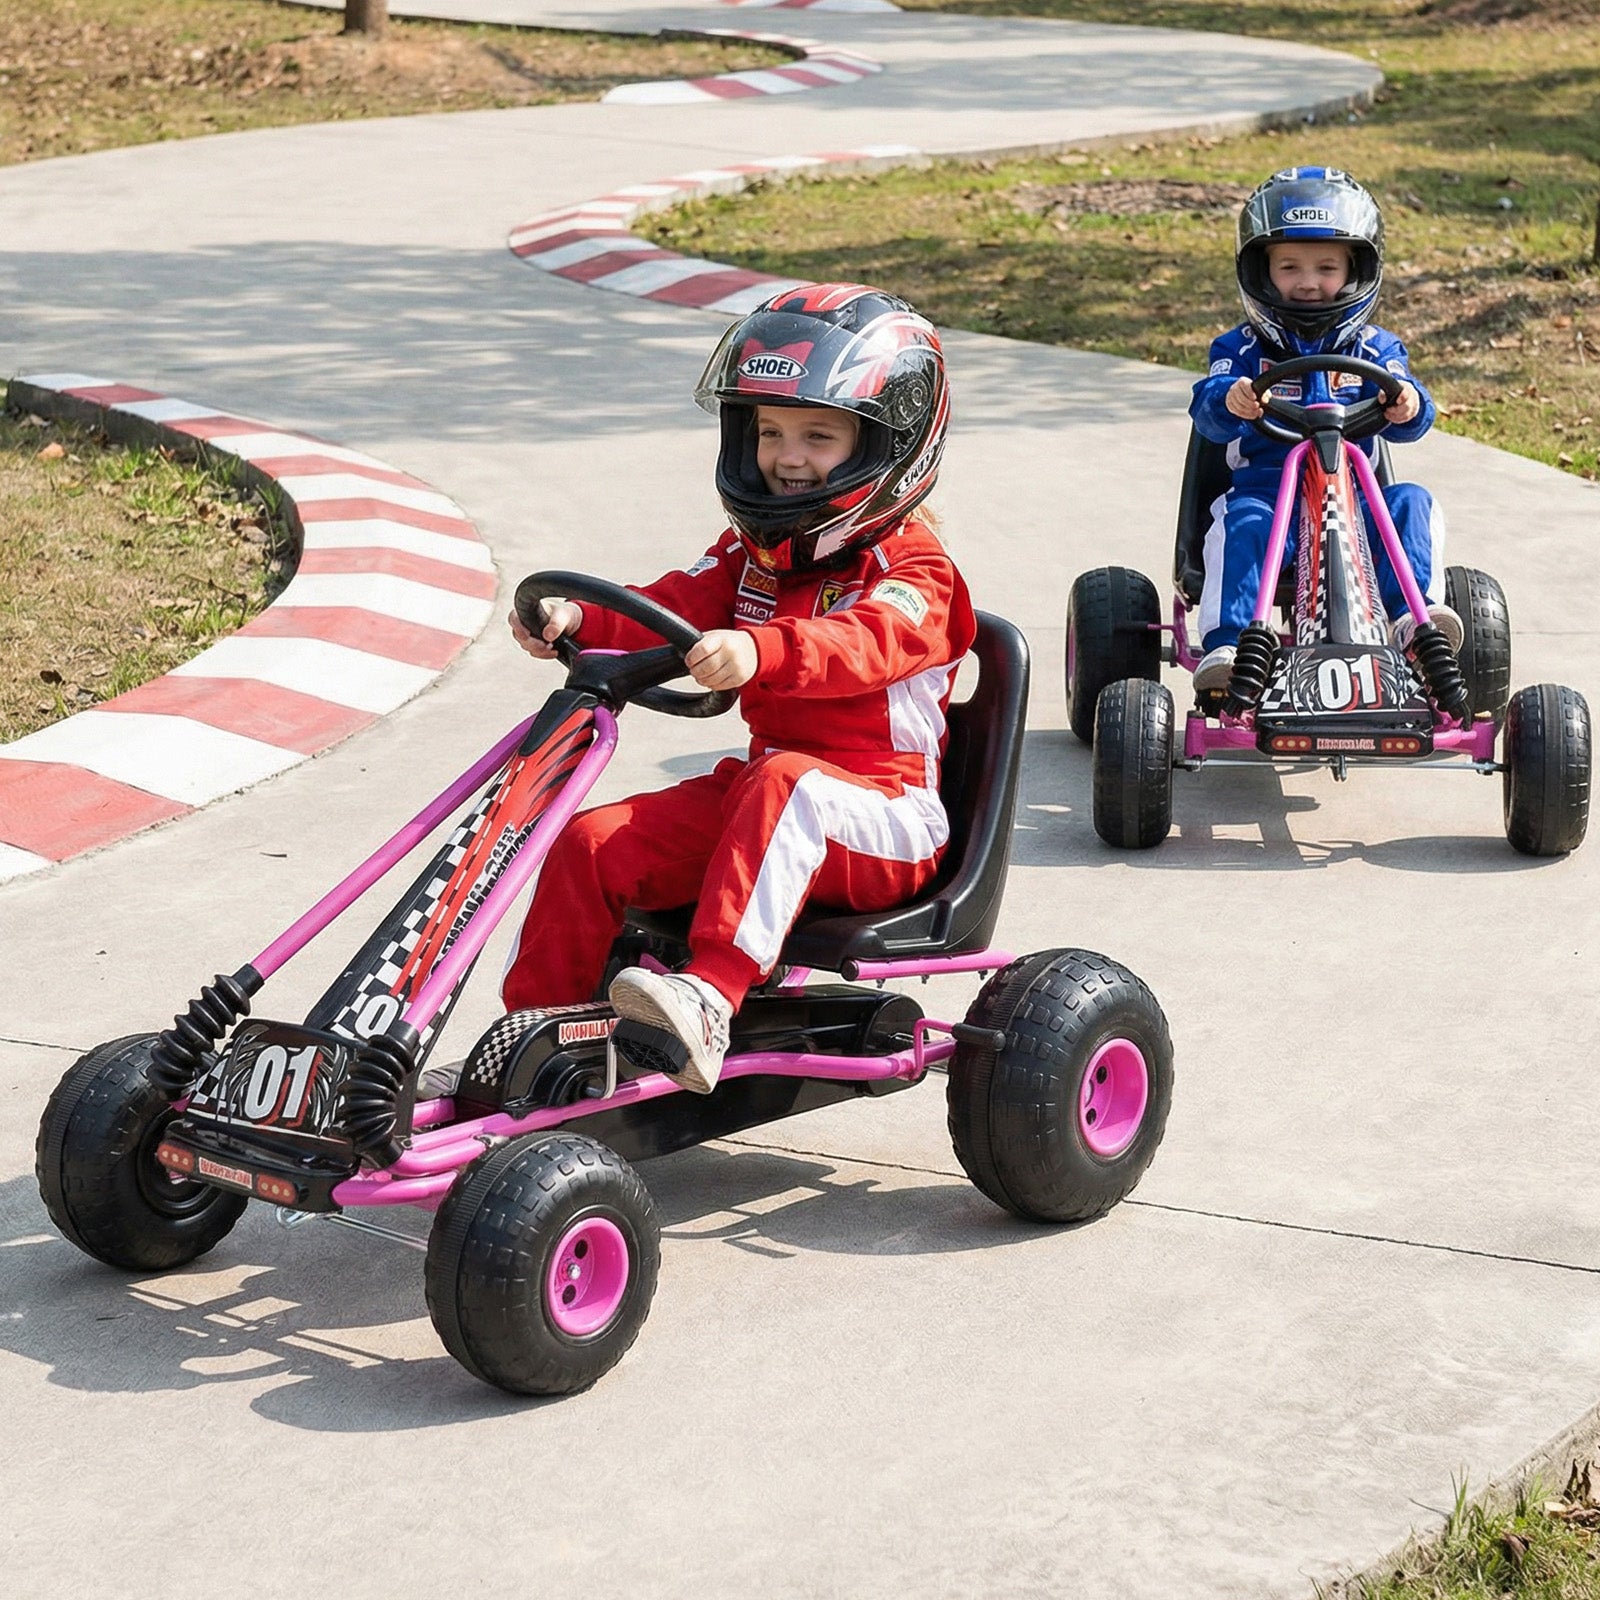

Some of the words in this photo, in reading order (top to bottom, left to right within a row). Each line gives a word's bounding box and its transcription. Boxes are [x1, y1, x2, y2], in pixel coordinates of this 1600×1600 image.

[1292, 209, 1329, 222] SHOEI
[746, 358, 794, 377] SHOEI
[1317, 655, 1375, 709] 01
[244, 1045, 318, 1119] 01
